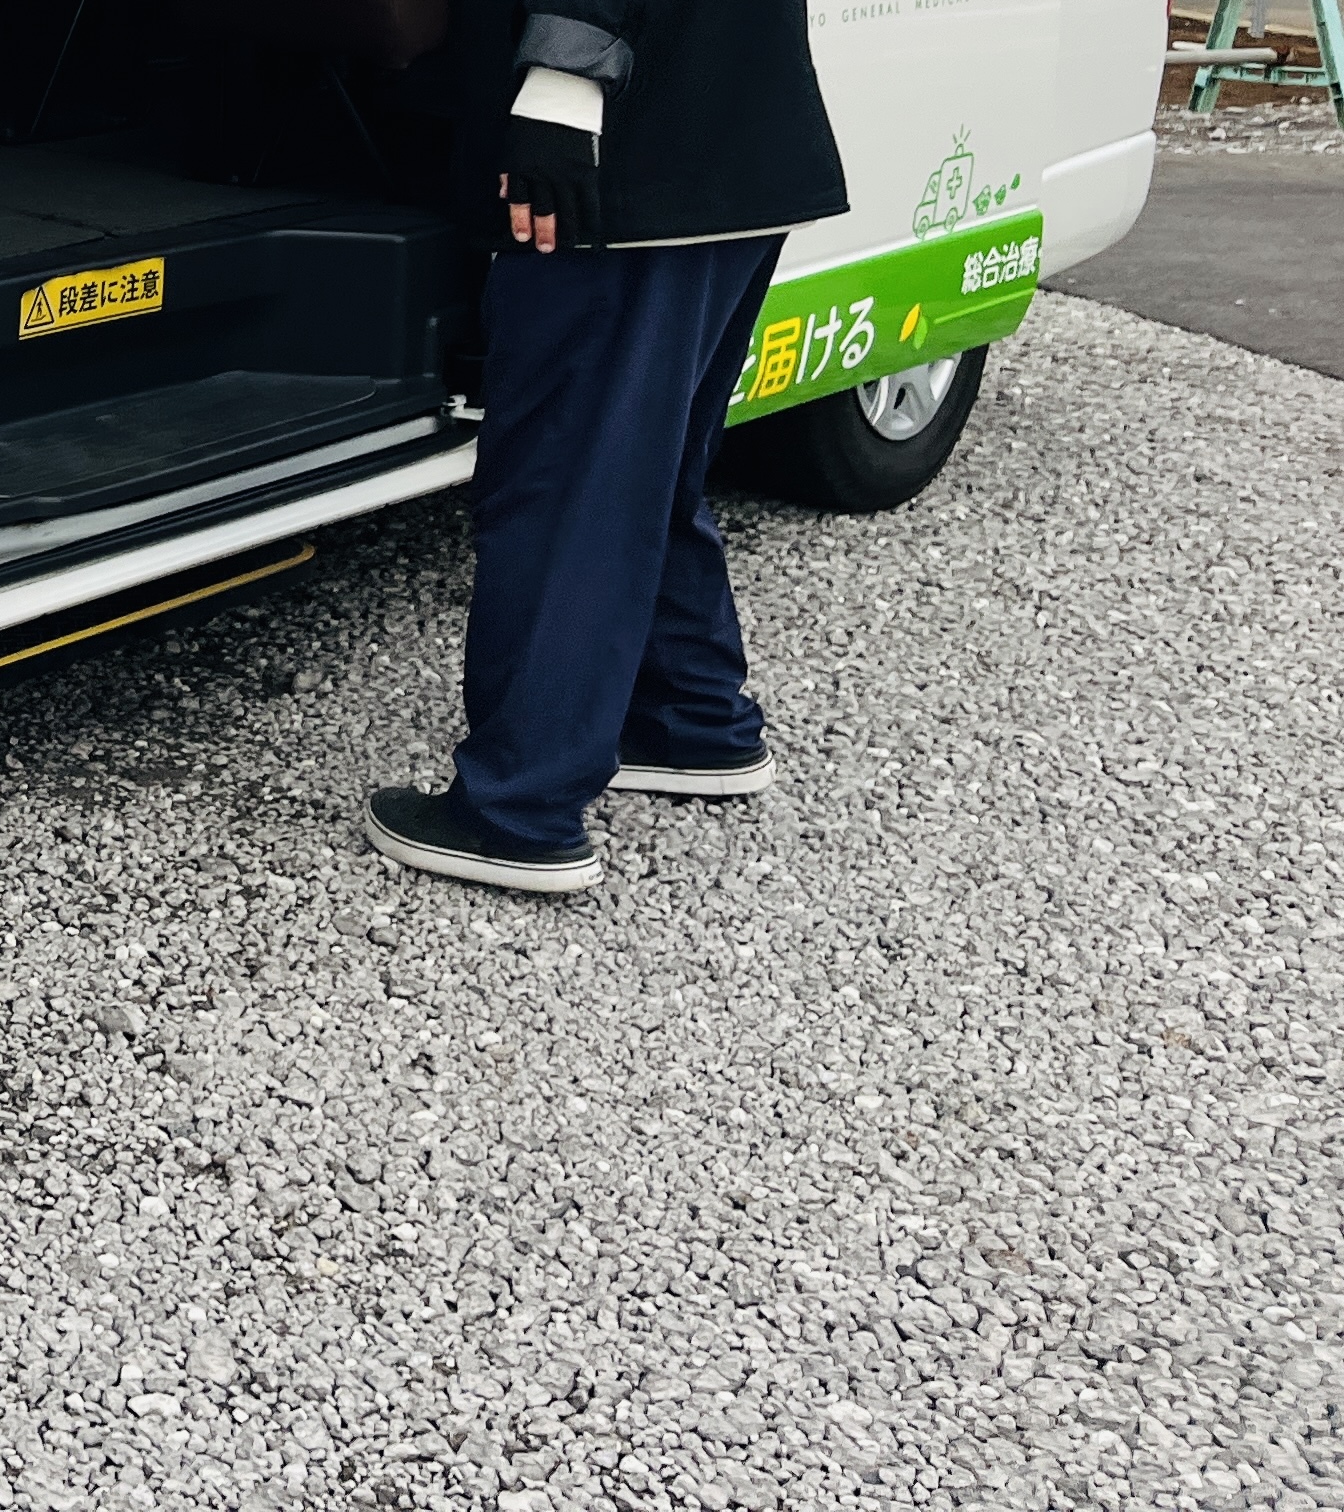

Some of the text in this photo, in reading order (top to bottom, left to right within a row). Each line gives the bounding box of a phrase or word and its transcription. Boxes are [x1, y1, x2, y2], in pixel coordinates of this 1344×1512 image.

[841, 1, 900, 23] GENERAL
[58, 269, 161, 318] 段差に注意
